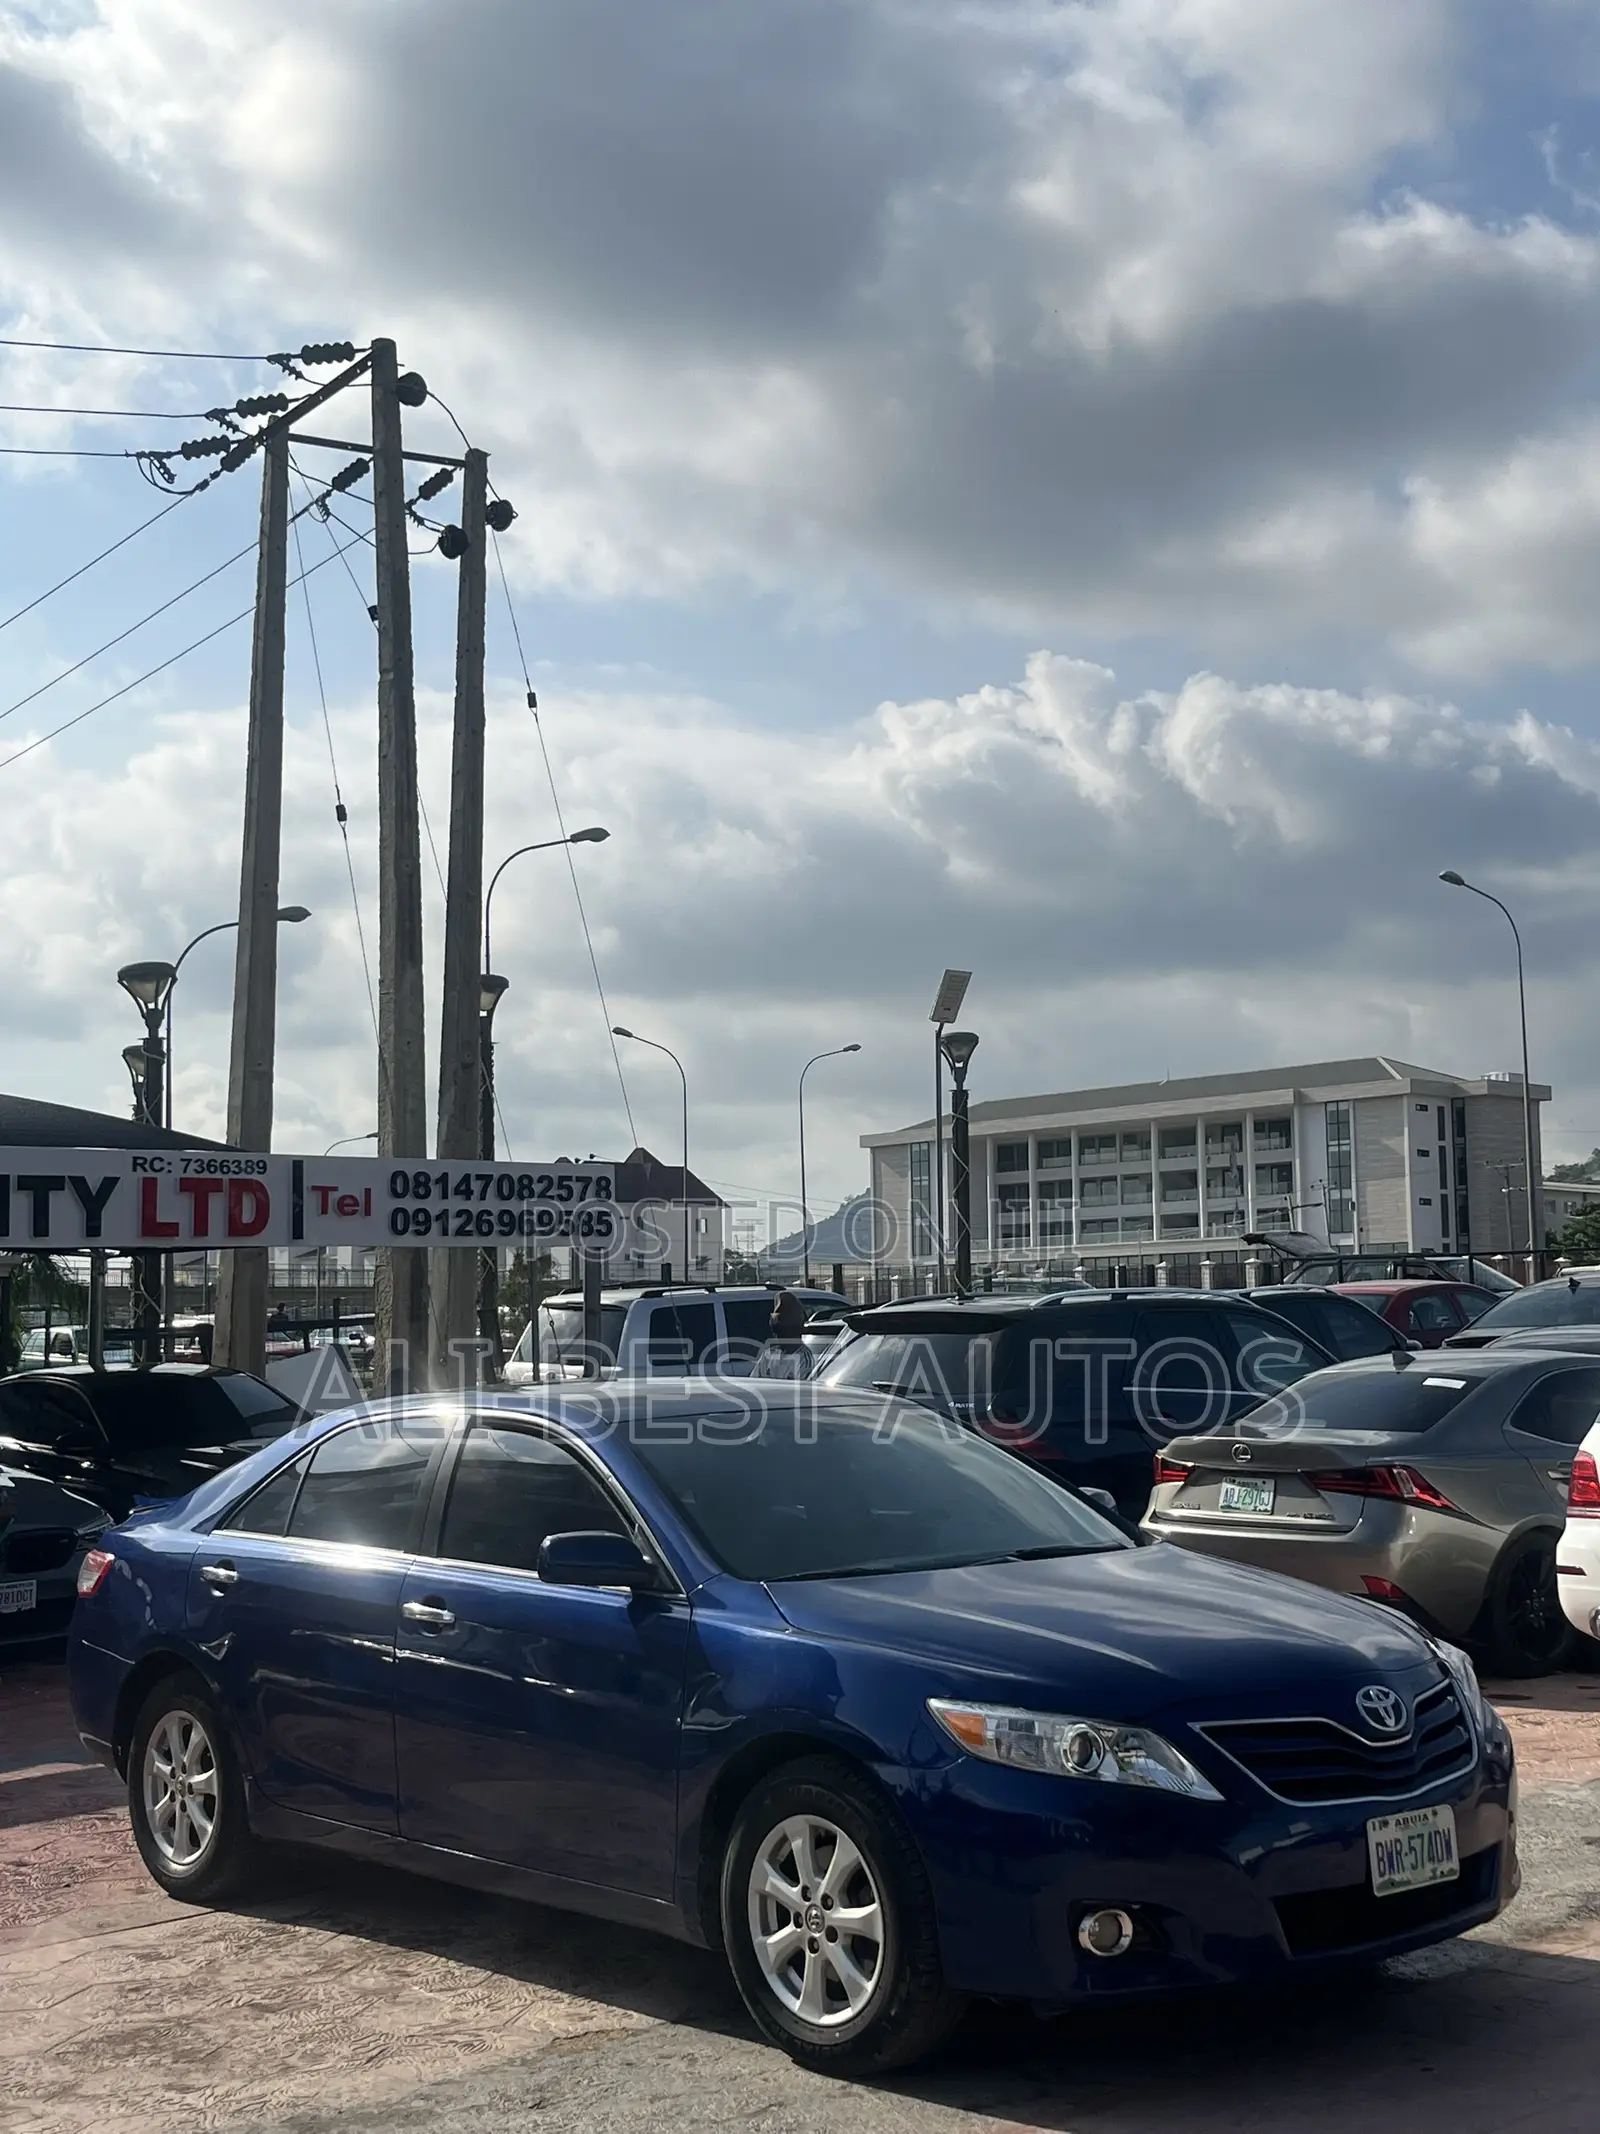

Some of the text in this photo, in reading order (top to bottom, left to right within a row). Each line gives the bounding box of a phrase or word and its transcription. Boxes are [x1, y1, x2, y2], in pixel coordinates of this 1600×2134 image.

[131, 1156, 268, 1175] RC: 7366389
[310, 1185, 372, 1216] Tel
[389, 1170, 613, 1202] 08147082578
[140, 1176, 271, 1237] LTD
[389, 1207, 613, 1238] 09126969585
